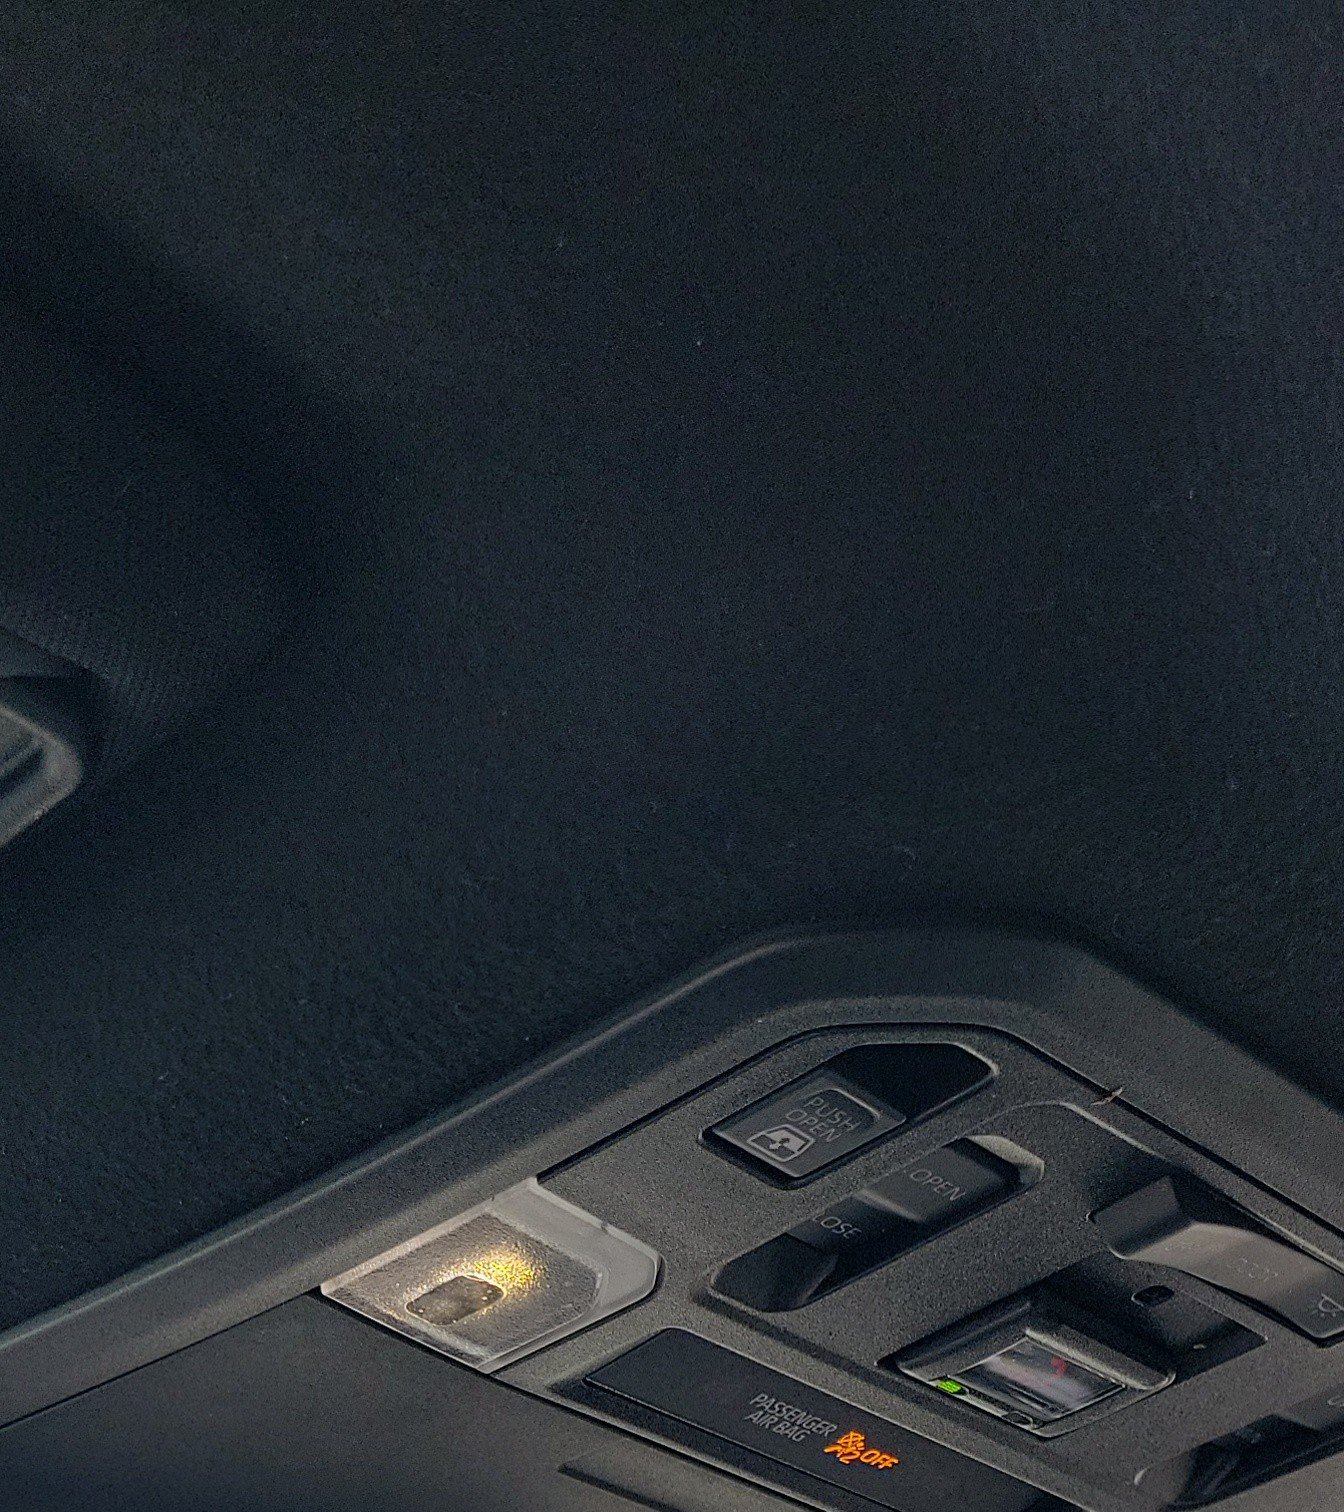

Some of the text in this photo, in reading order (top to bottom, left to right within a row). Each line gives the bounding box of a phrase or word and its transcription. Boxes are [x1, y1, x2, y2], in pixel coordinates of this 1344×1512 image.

[785, 1109, 842, 1143] OPEN
[805, 1096, 861, 1132] PUSH
[910, 1168, 967, 1201] OPEN
[812, 1213, 863, 1240] LOSE
[744, 1410, 811, 1443] AIR BAG
[749, 1393, 838, 1437] PASSENGER
[859, 1449, 899, 1469] OFF
